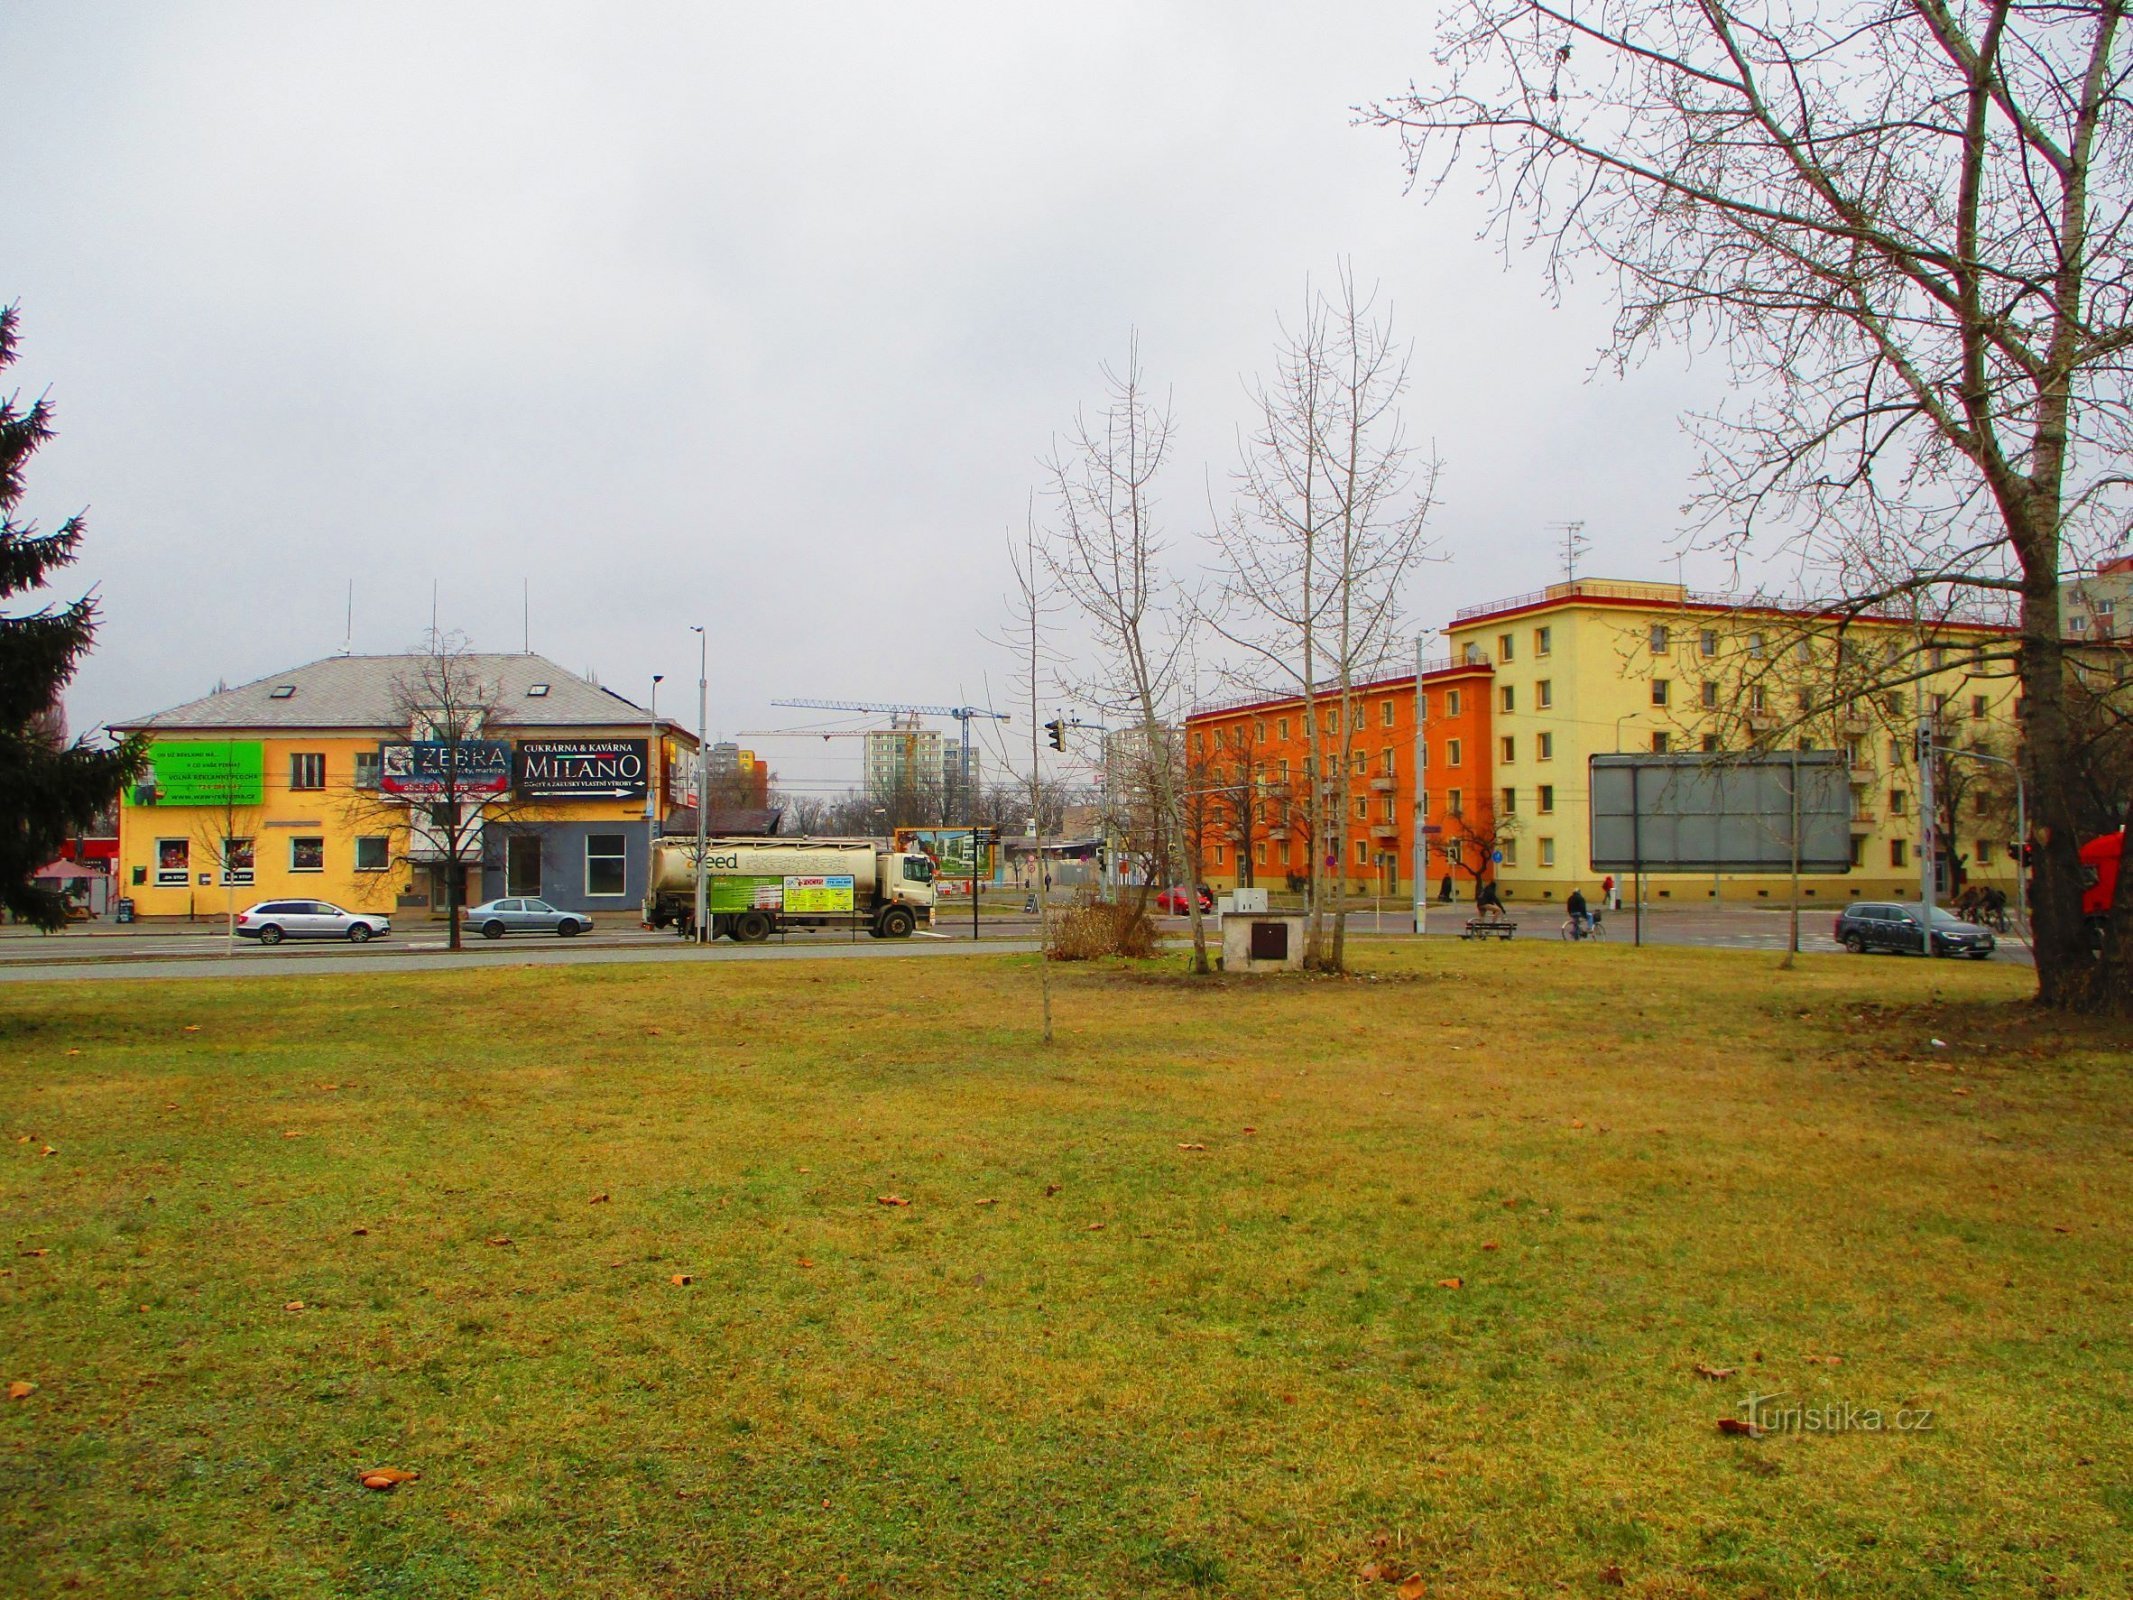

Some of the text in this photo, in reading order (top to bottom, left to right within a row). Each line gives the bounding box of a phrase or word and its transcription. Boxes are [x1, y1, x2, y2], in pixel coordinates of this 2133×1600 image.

[421, 747, 507, 767] ZEBRA
[524, 742, 633, 753] CUKRÁRNA & KAVÁRNA
[524, 754, 642, 779] MILANO
